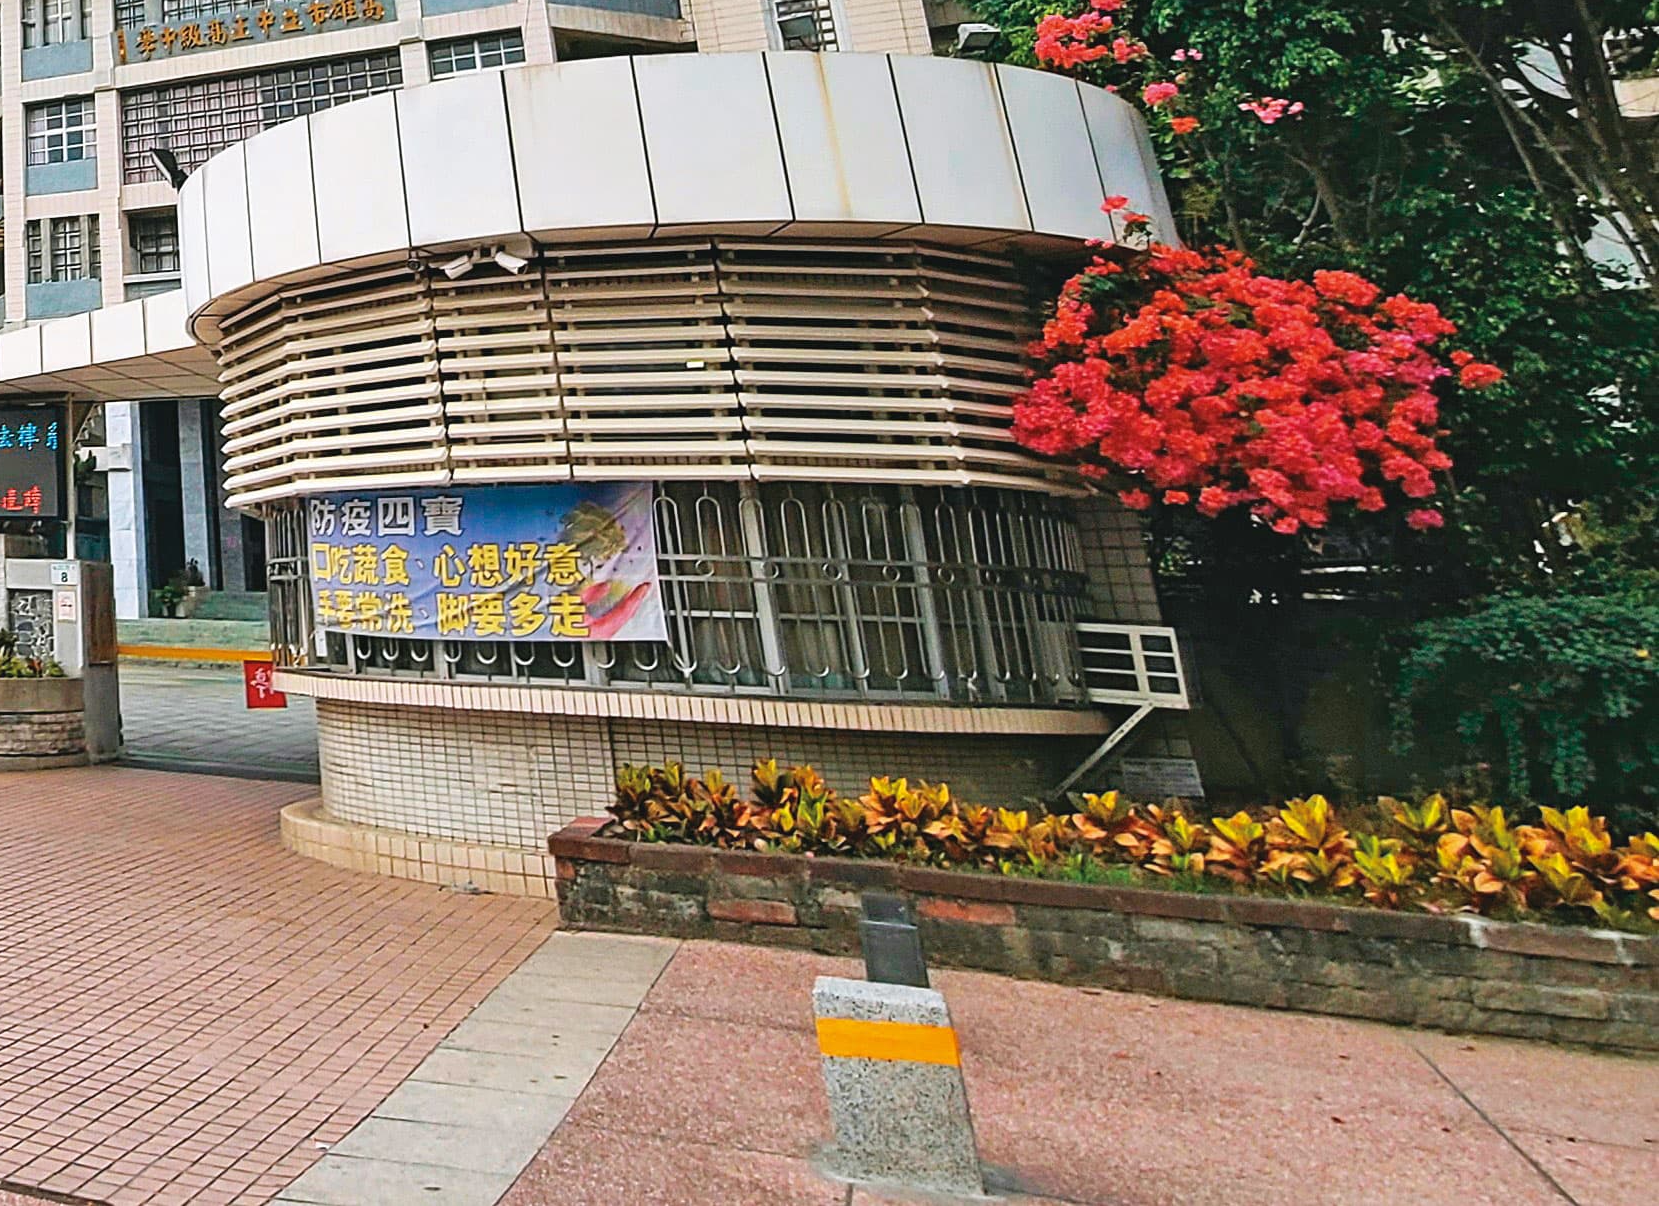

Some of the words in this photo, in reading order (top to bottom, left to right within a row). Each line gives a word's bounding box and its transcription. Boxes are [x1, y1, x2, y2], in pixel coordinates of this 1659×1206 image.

[310, 496, 463, 538] 防疫四寶
[61, 572, 68, 583] 8
